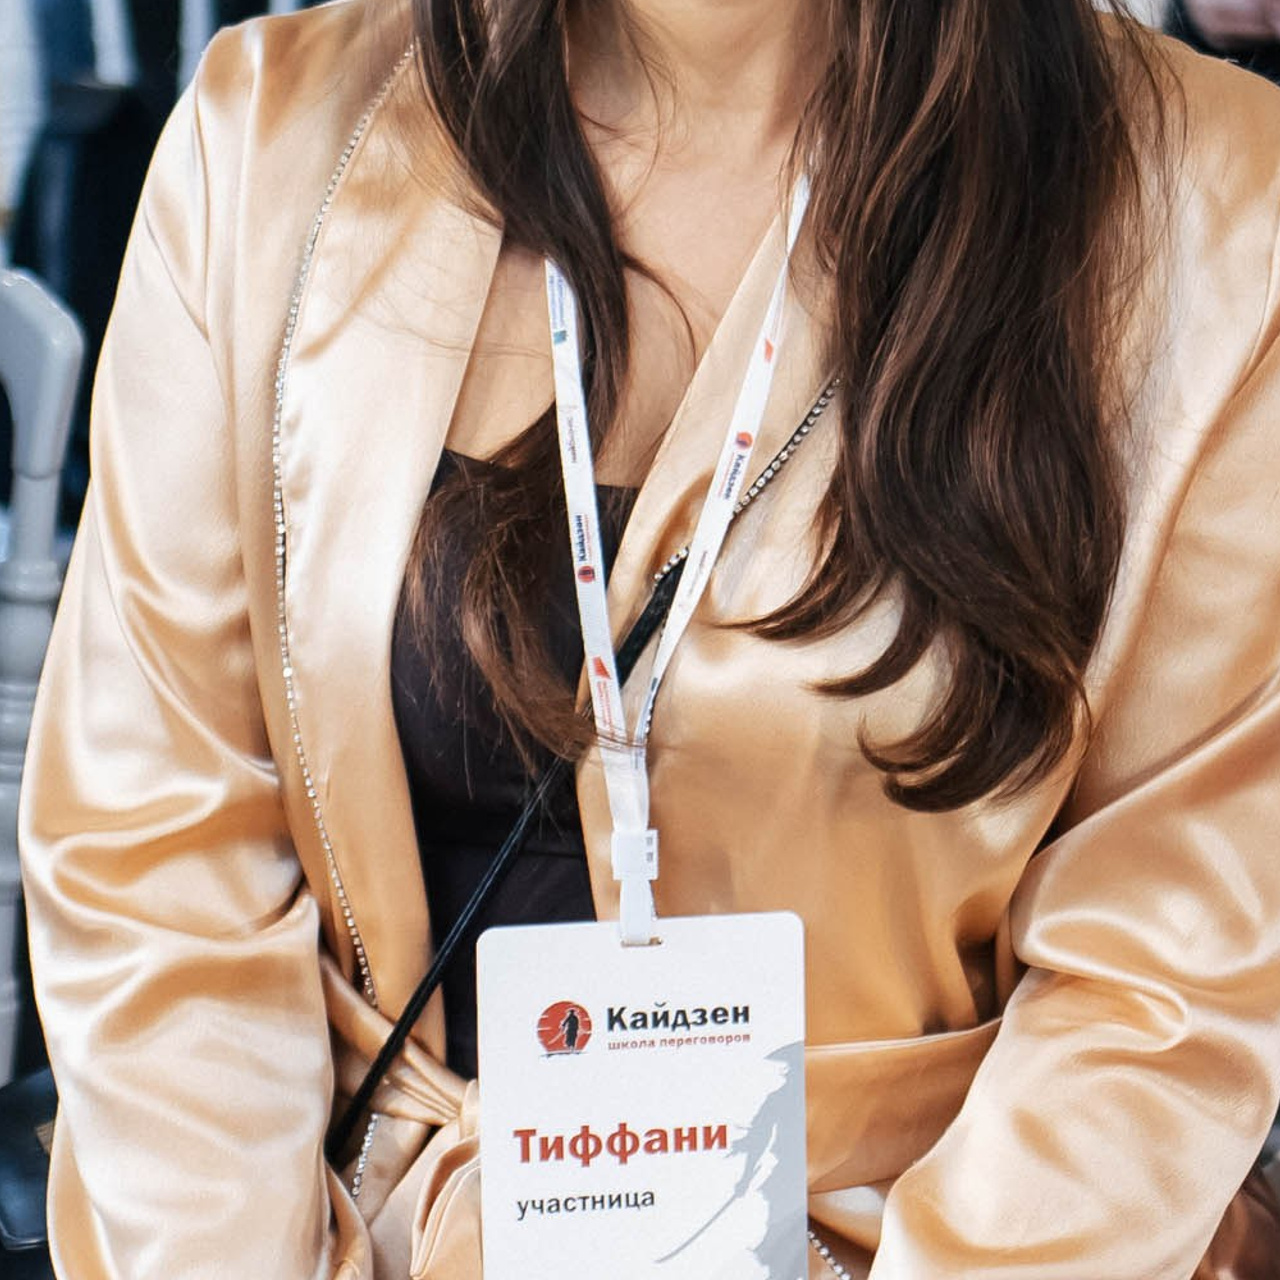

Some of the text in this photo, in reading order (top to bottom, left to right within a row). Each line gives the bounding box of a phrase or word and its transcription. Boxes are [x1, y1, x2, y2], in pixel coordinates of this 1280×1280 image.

[606, 1001, 751, 1032] Кайдзен
[607, 1033, 751, 1051] школа переговоров
[513, 1122, 729, 1168] Тиффани
[516, 1191, 656, 1222] участница
